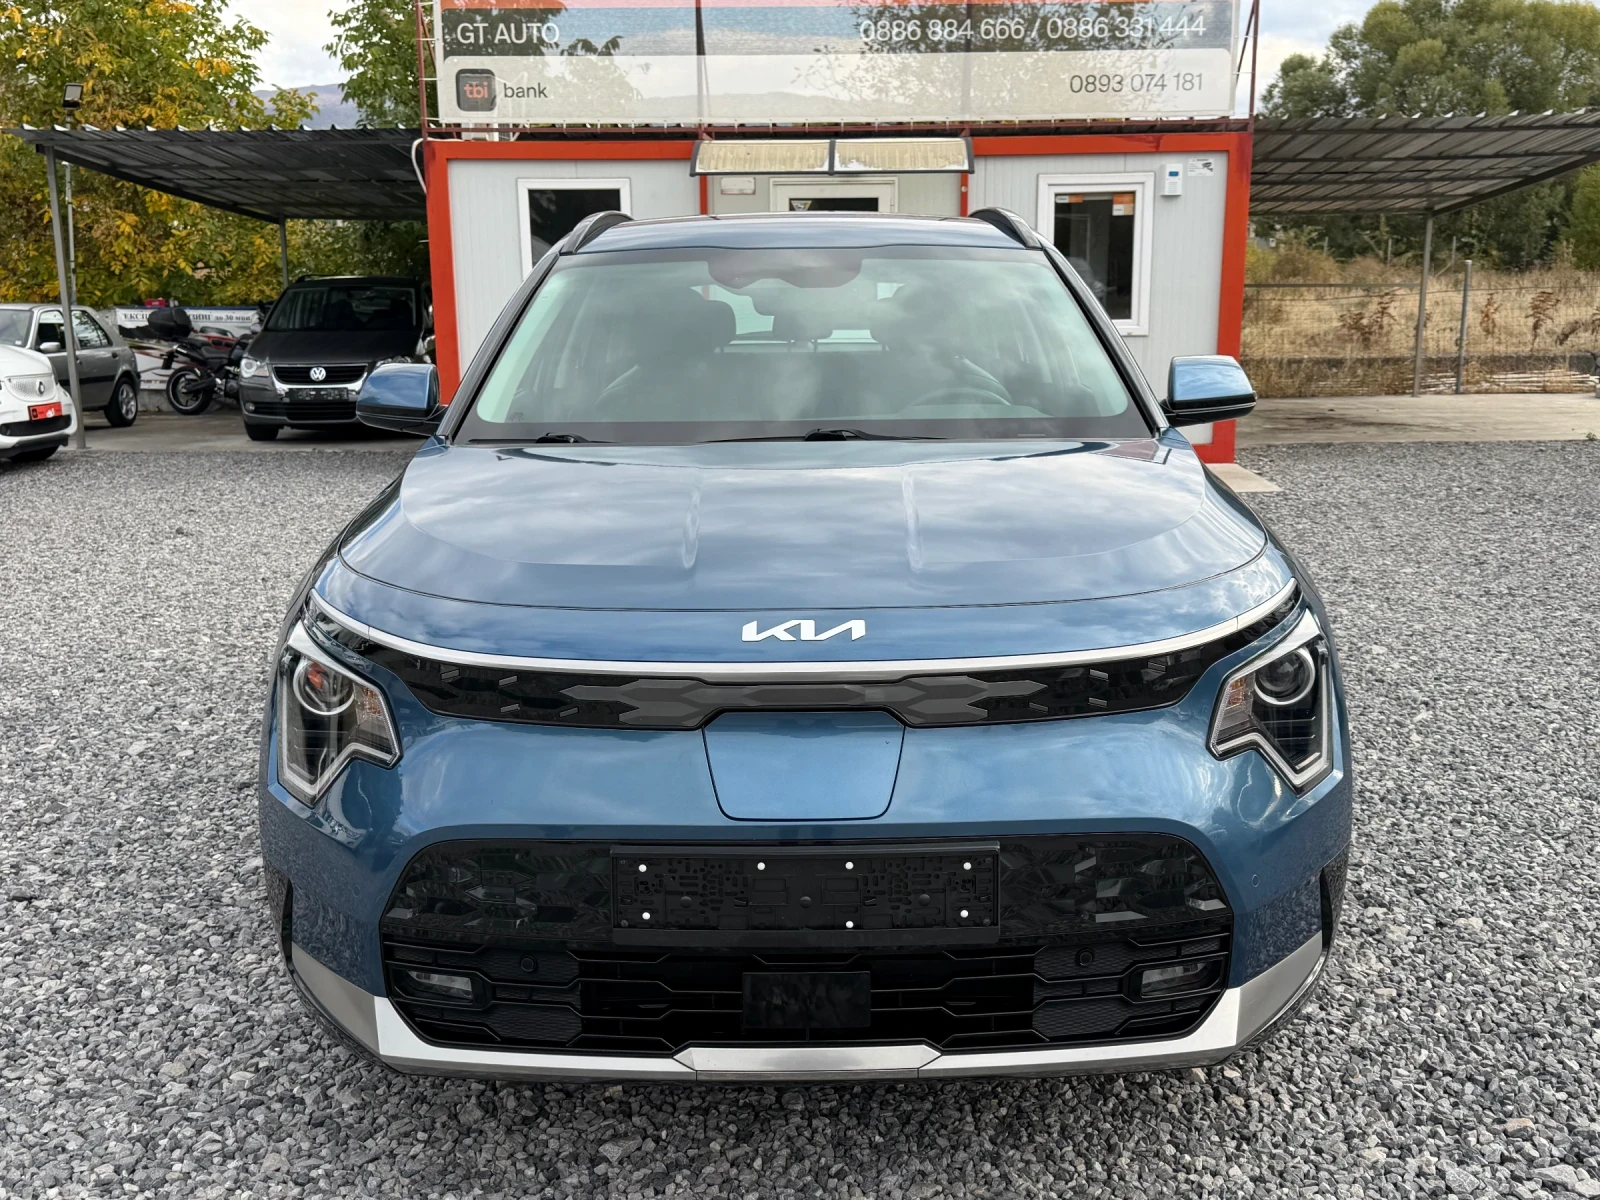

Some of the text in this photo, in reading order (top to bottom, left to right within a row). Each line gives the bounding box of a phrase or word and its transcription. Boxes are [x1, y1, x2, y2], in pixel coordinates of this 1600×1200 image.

[457, 22, 561, 44] GT AUTO
[860, 20, 922, 42] 0886
[928, 19, 974, 41] 884
[980, 18, 1025, 40] 666
[1046, 16, 1109, 39] 0886
[1116, 16, 1154, 38] 331
[1158, 15, 1207, 37] 444
[463, 81, 548, 99] tbi bank
[1070, 72, 1204, 94] 0893 074 181
[742, 619, 866, 642] KIA
